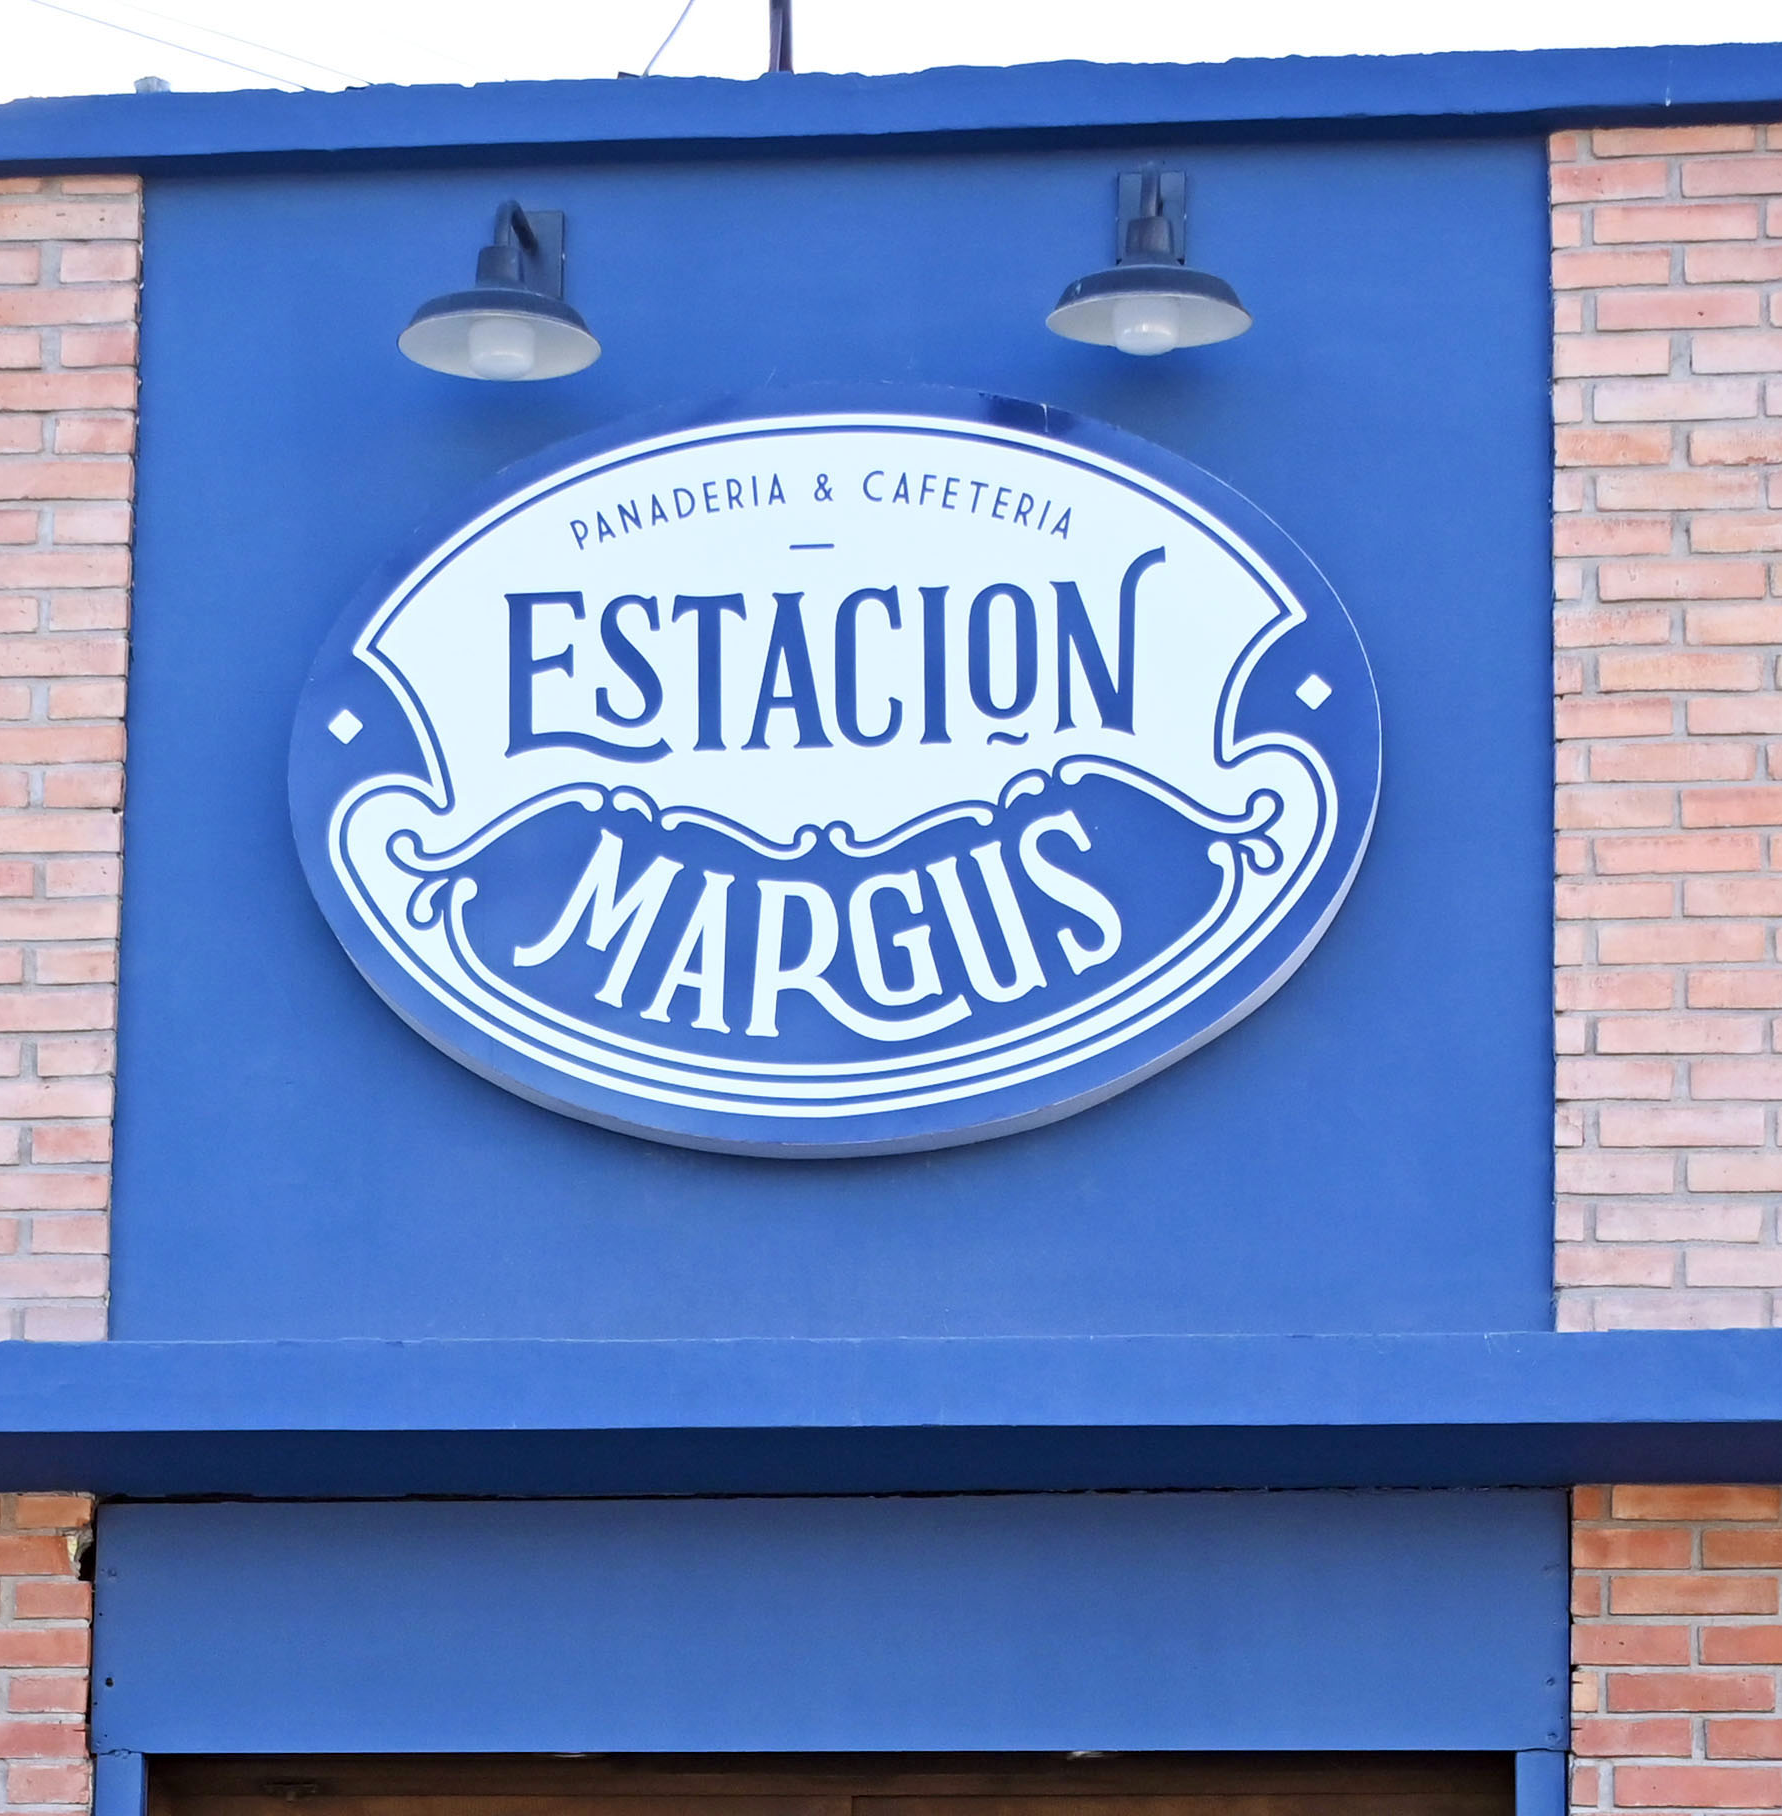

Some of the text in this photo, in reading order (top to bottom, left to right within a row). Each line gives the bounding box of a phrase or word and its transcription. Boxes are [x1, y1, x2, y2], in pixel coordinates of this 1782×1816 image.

[569, 470, 1073, 551] PANADERIA & CAFETERIA
[502, 545, 1167, 763] ESTACION
[514, 810, 1123, 1043] MARGUS
